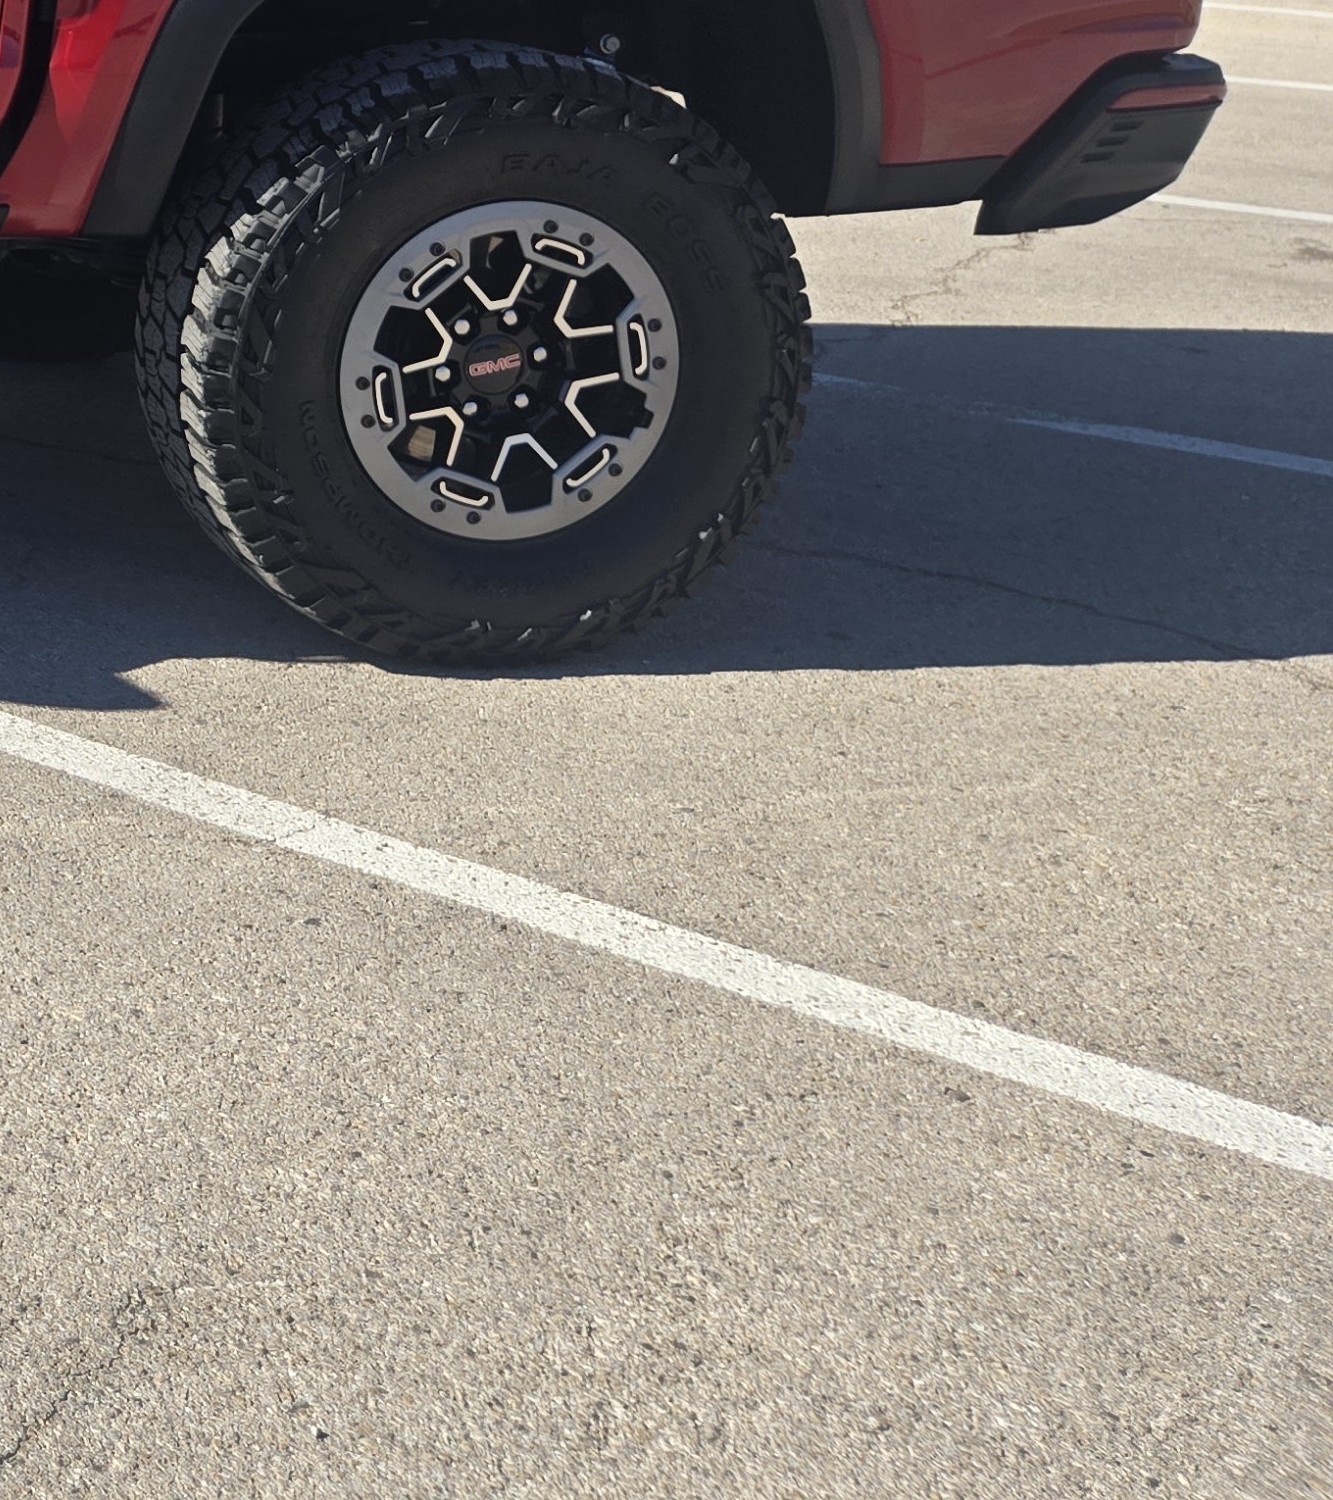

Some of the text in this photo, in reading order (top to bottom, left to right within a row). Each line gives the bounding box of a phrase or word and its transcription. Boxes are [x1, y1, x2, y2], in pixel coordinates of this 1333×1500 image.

[500, 152, 724, 295] BAJA BOSS
[469, 353, 521, 376] GMC
